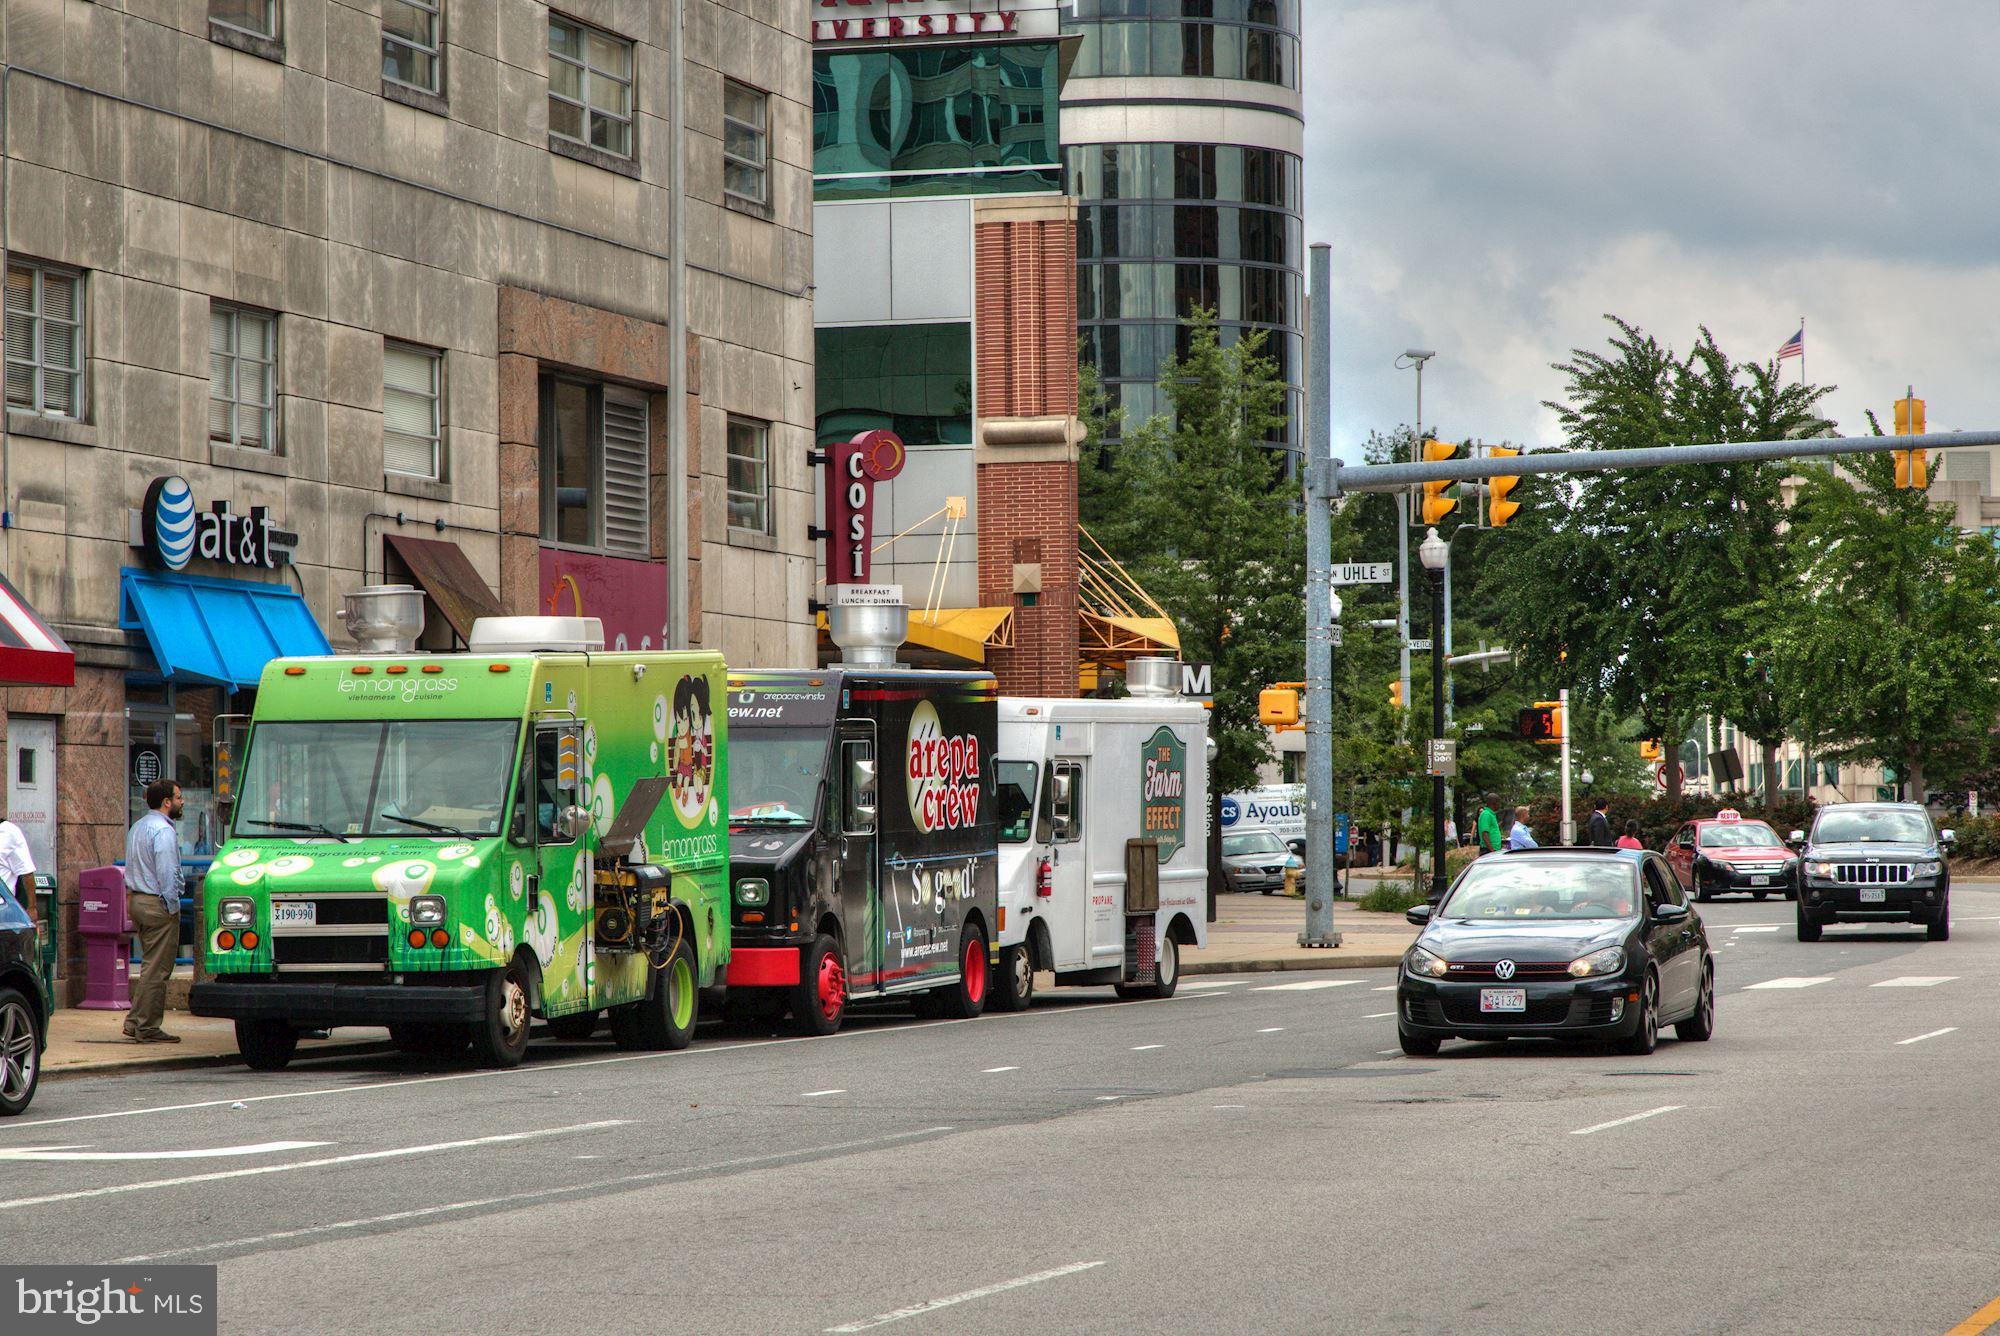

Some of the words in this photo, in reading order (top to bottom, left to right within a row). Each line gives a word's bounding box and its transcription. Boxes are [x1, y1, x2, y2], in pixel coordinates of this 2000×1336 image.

[200, 500, 275, 569] at&t
[1343, 565, 1377, 581] UHLE
[1382, 568, 1390, 577] ST
[337, 670, 458, 702] lemongrass
[1182, 665, 1212, 694] M
[763, 692, 826, 701] arepacrewinsta
[1542, 713, 1551, 734] 5
[909, 734, 979, 787] arepa
[1158, 746, 1171, 762] THE
[1145, 758, 1182, 802] Farm
[923, 784, 979, 832] crew
[1146, 805, 1181, 831] EFFECT
[1221, 806, 1236, 818] CS
[1246, 800, 1301, 823] Ayoub
[662, 824, 717, 869] lemongrass
[1092, 895, 1113, 905] PROPANE
